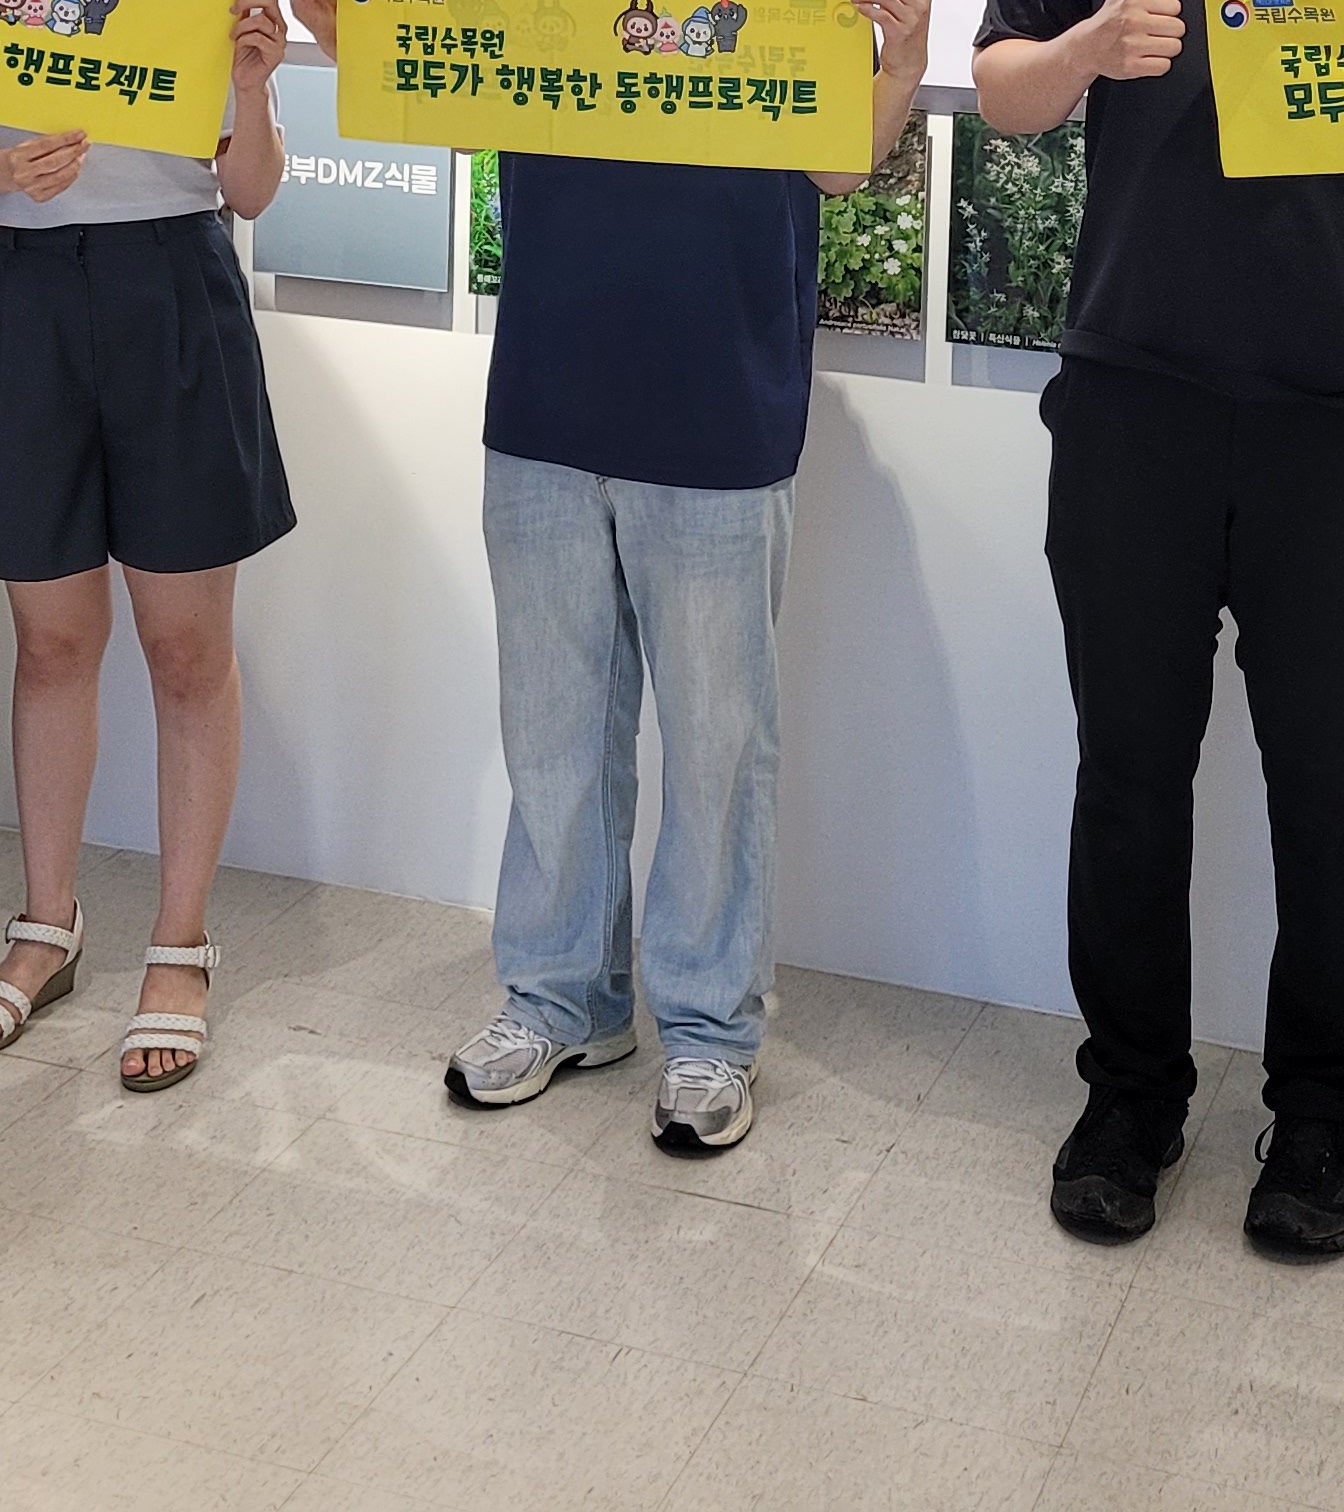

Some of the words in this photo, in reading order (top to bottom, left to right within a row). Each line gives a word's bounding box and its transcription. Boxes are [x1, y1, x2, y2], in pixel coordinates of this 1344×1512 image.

[1254, 8, 1336, 24] 국립수목원
[396, 24, 504, 59] 국립수목원
[396, 59, 484, 98] 모두가
[495, 63, 602, 112] 행복한
[615, 69, 818, 122] 동행프로젝트
